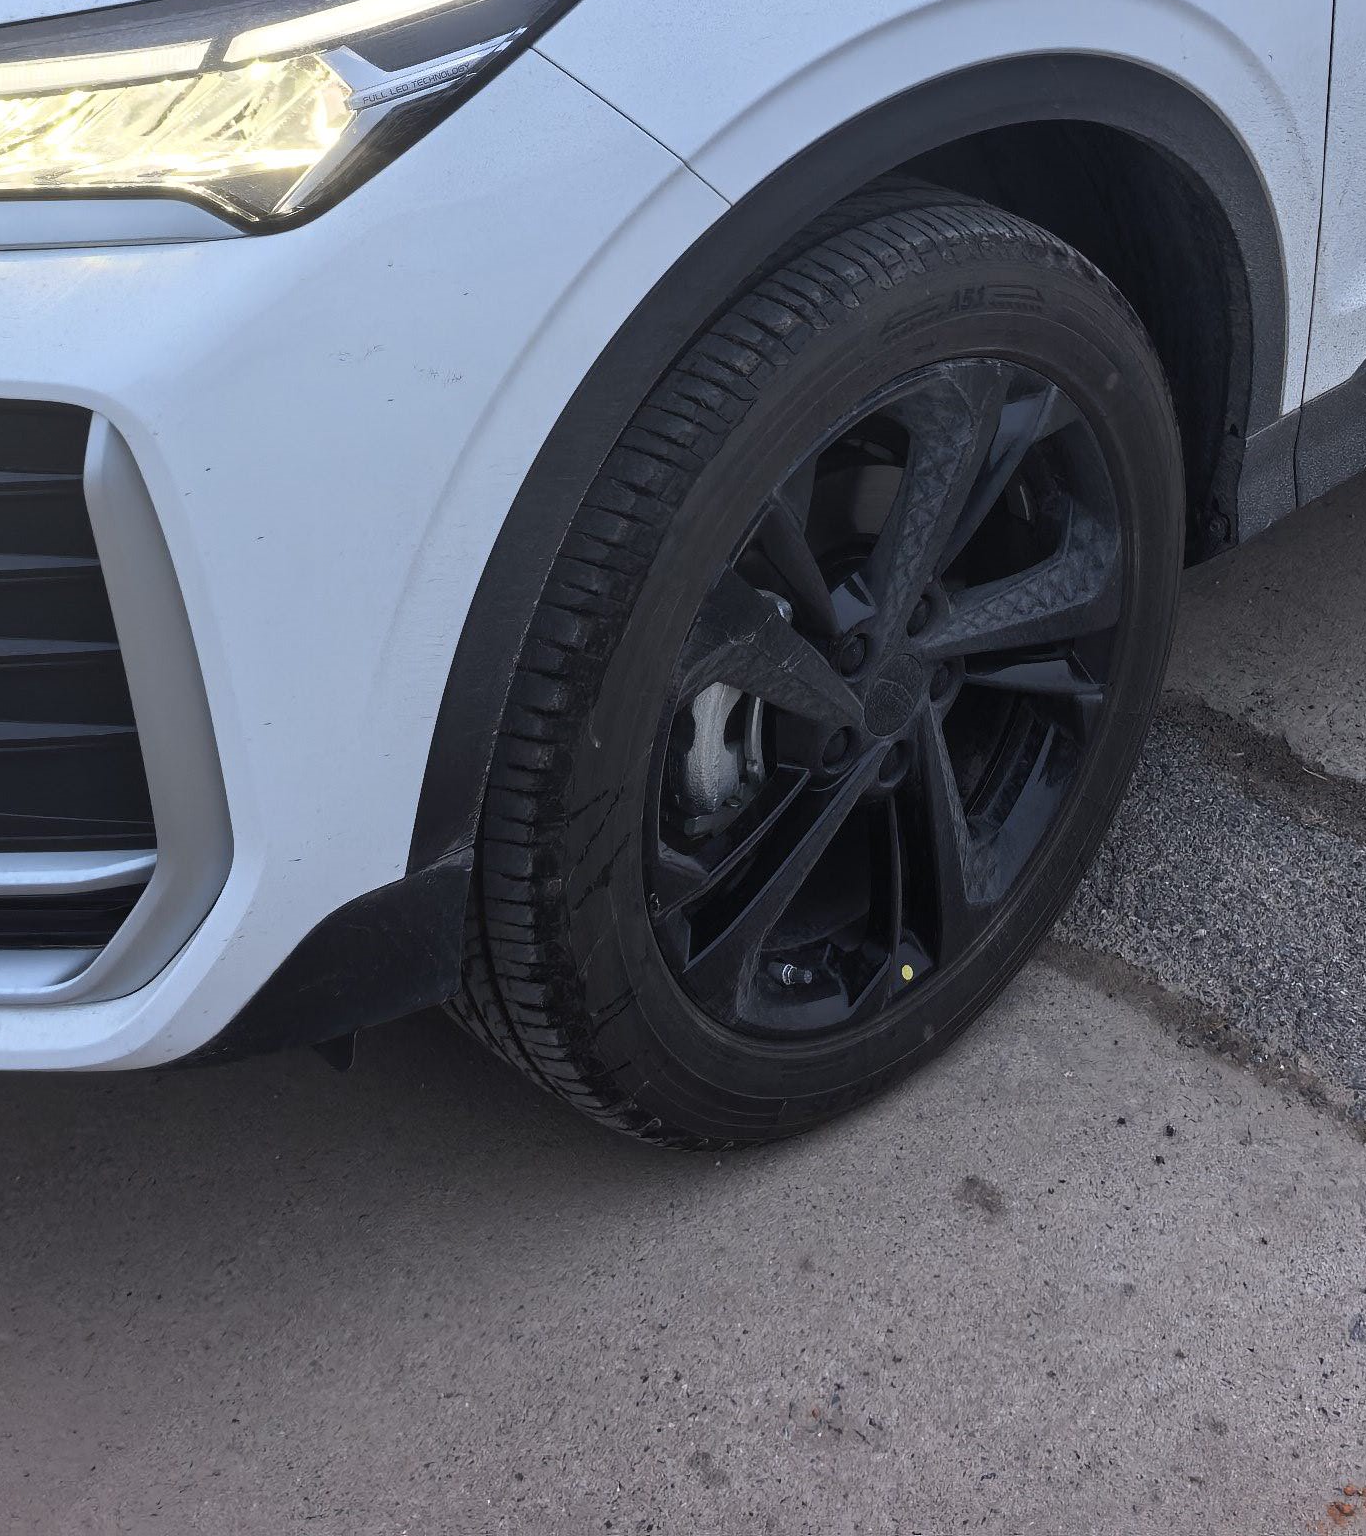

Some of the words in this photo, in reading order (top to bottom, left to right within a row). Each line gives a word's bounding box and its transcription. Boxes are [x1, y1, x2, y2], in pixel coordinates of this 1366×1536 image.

[362, 91, 388, 105] FULL
[389, 83, 409, 95] LED
[411, 63, 470, 89] TECHNOLOGY
